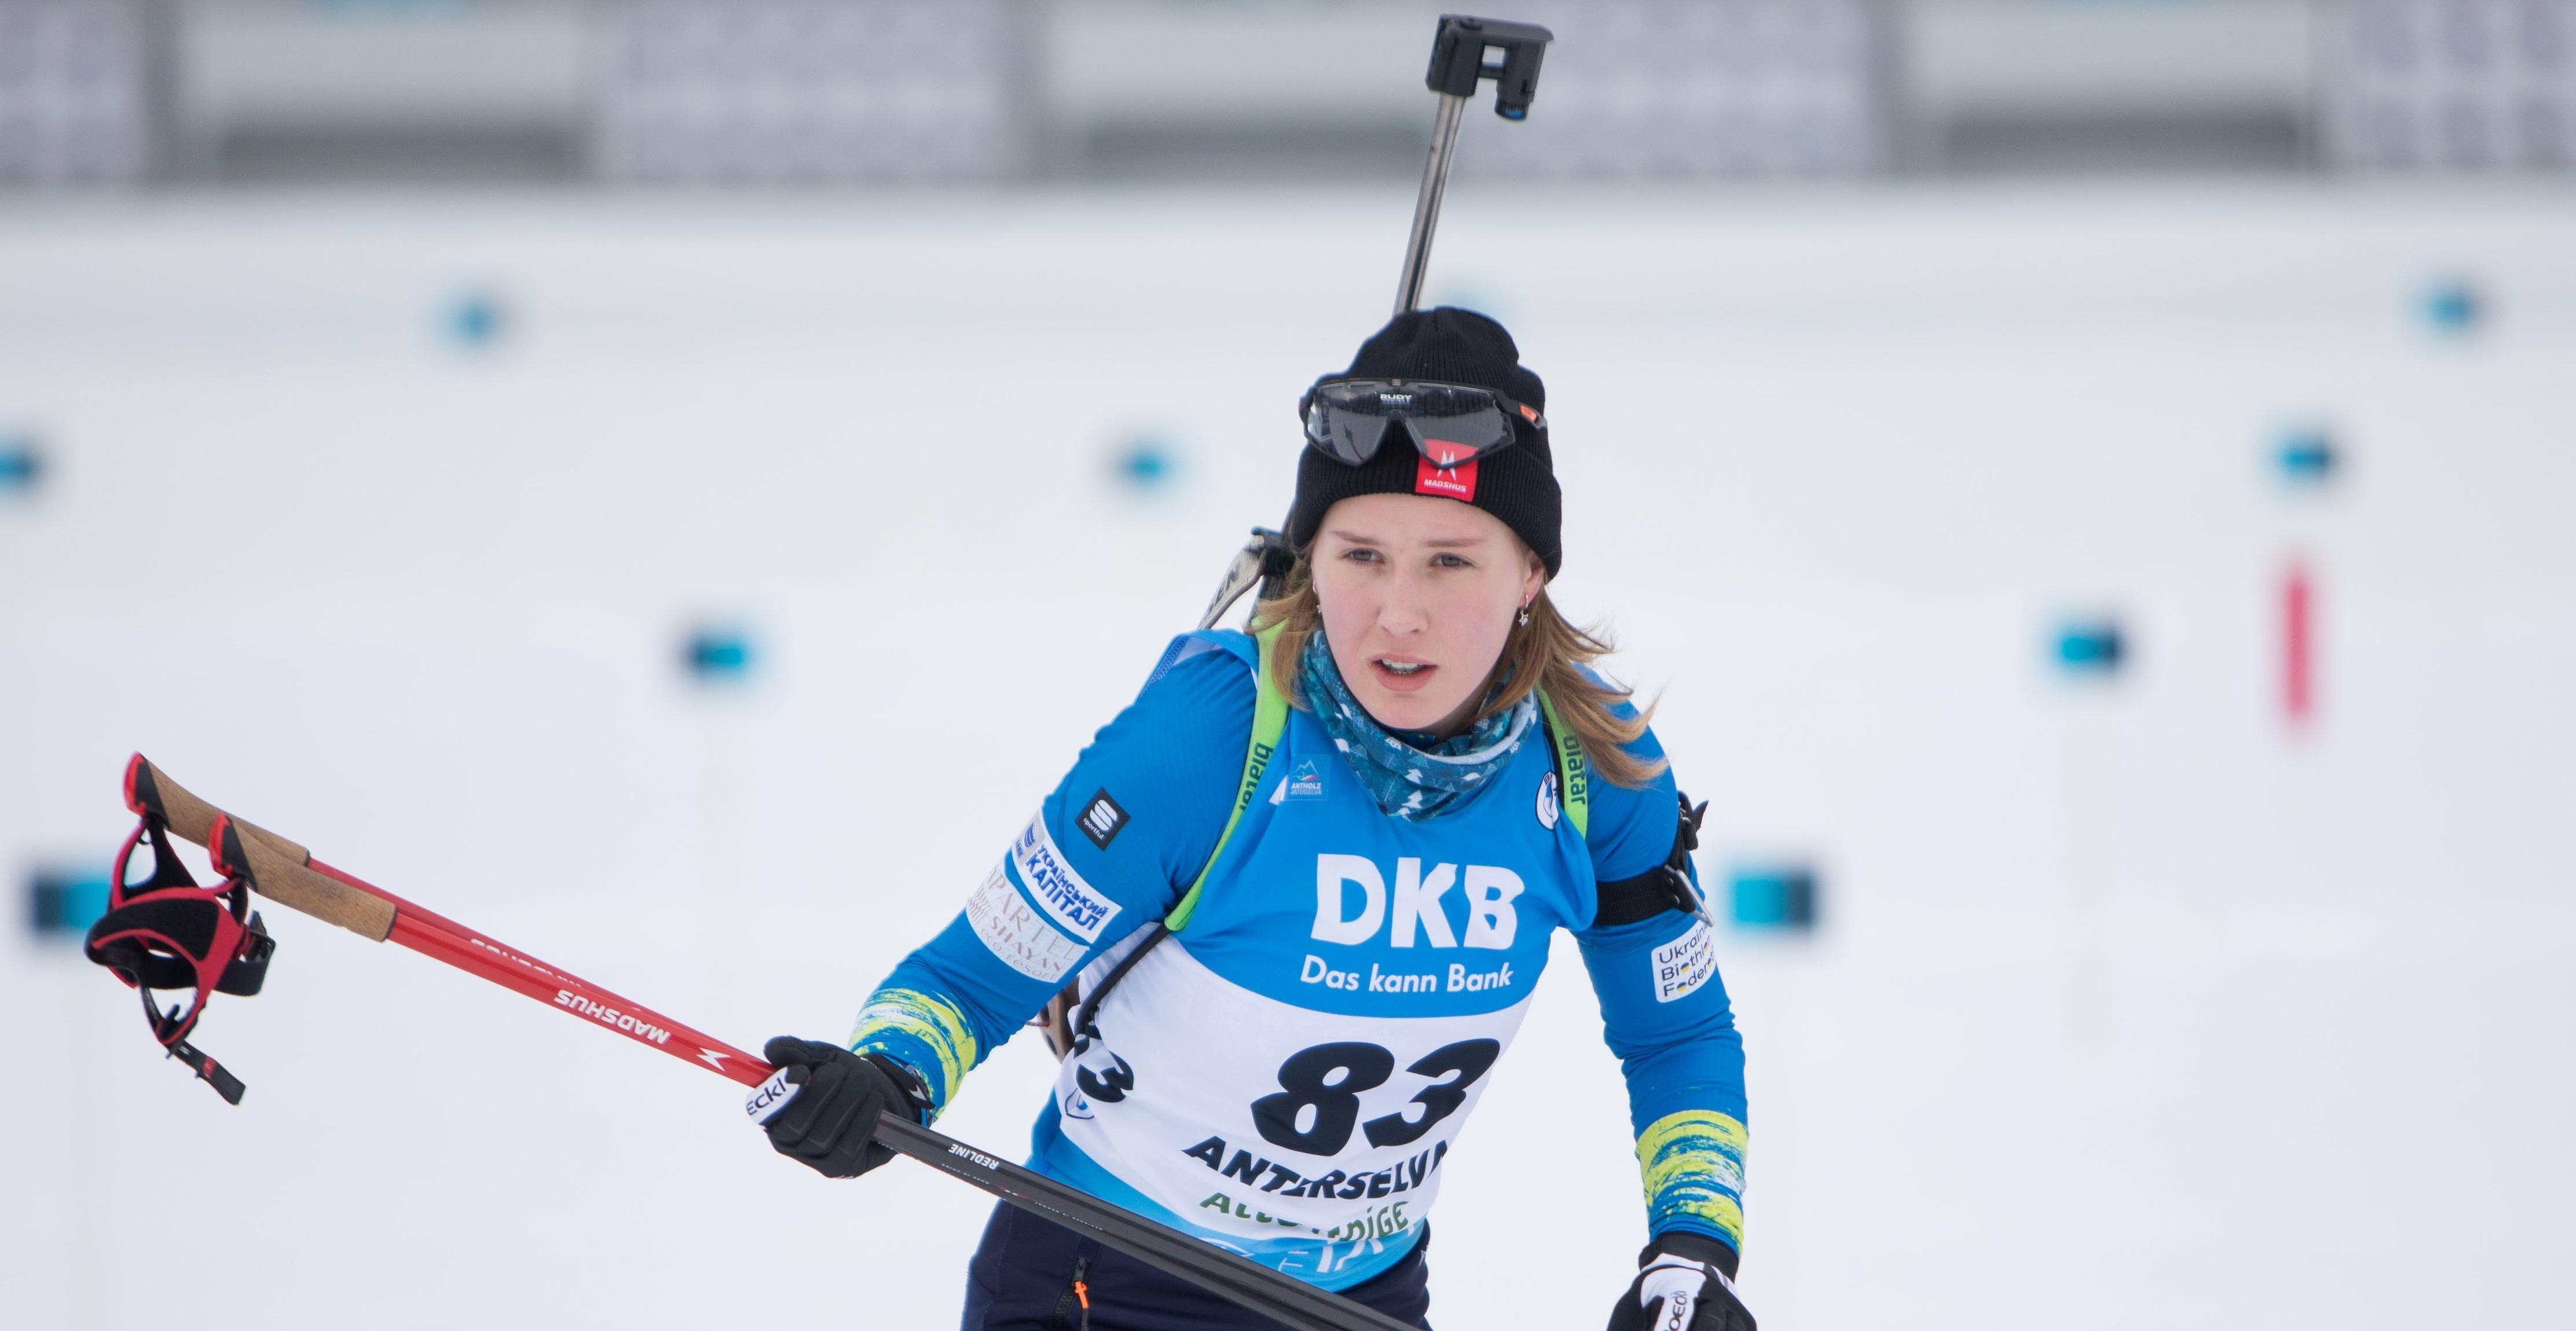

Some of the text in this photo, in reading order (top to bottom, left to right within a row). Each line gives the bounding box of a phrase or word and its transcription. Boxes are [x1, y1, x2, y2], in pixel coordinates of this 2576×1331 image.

[1424, 479, 1467, 492] MADSHUS
[1083, 817, 1106, 839] sportful
[1025, 853, 1100, 930] КАПІТАЛ
[1038, 843, 1108, 917] УКРАЇНСЬКИЙ
[1310, 853, 1525, 950] DKB
[981, 928, 1001, 952] eco
[990, 916, 1065, 972] SHAYAN
[1300, 954, 1514, 992] Das kann Bank
[554, 989, 670, 1044] MADSHUS
[1251, 1038, 1500, 1157] 83
[948, 1143, 999, 1171] REDLINE
